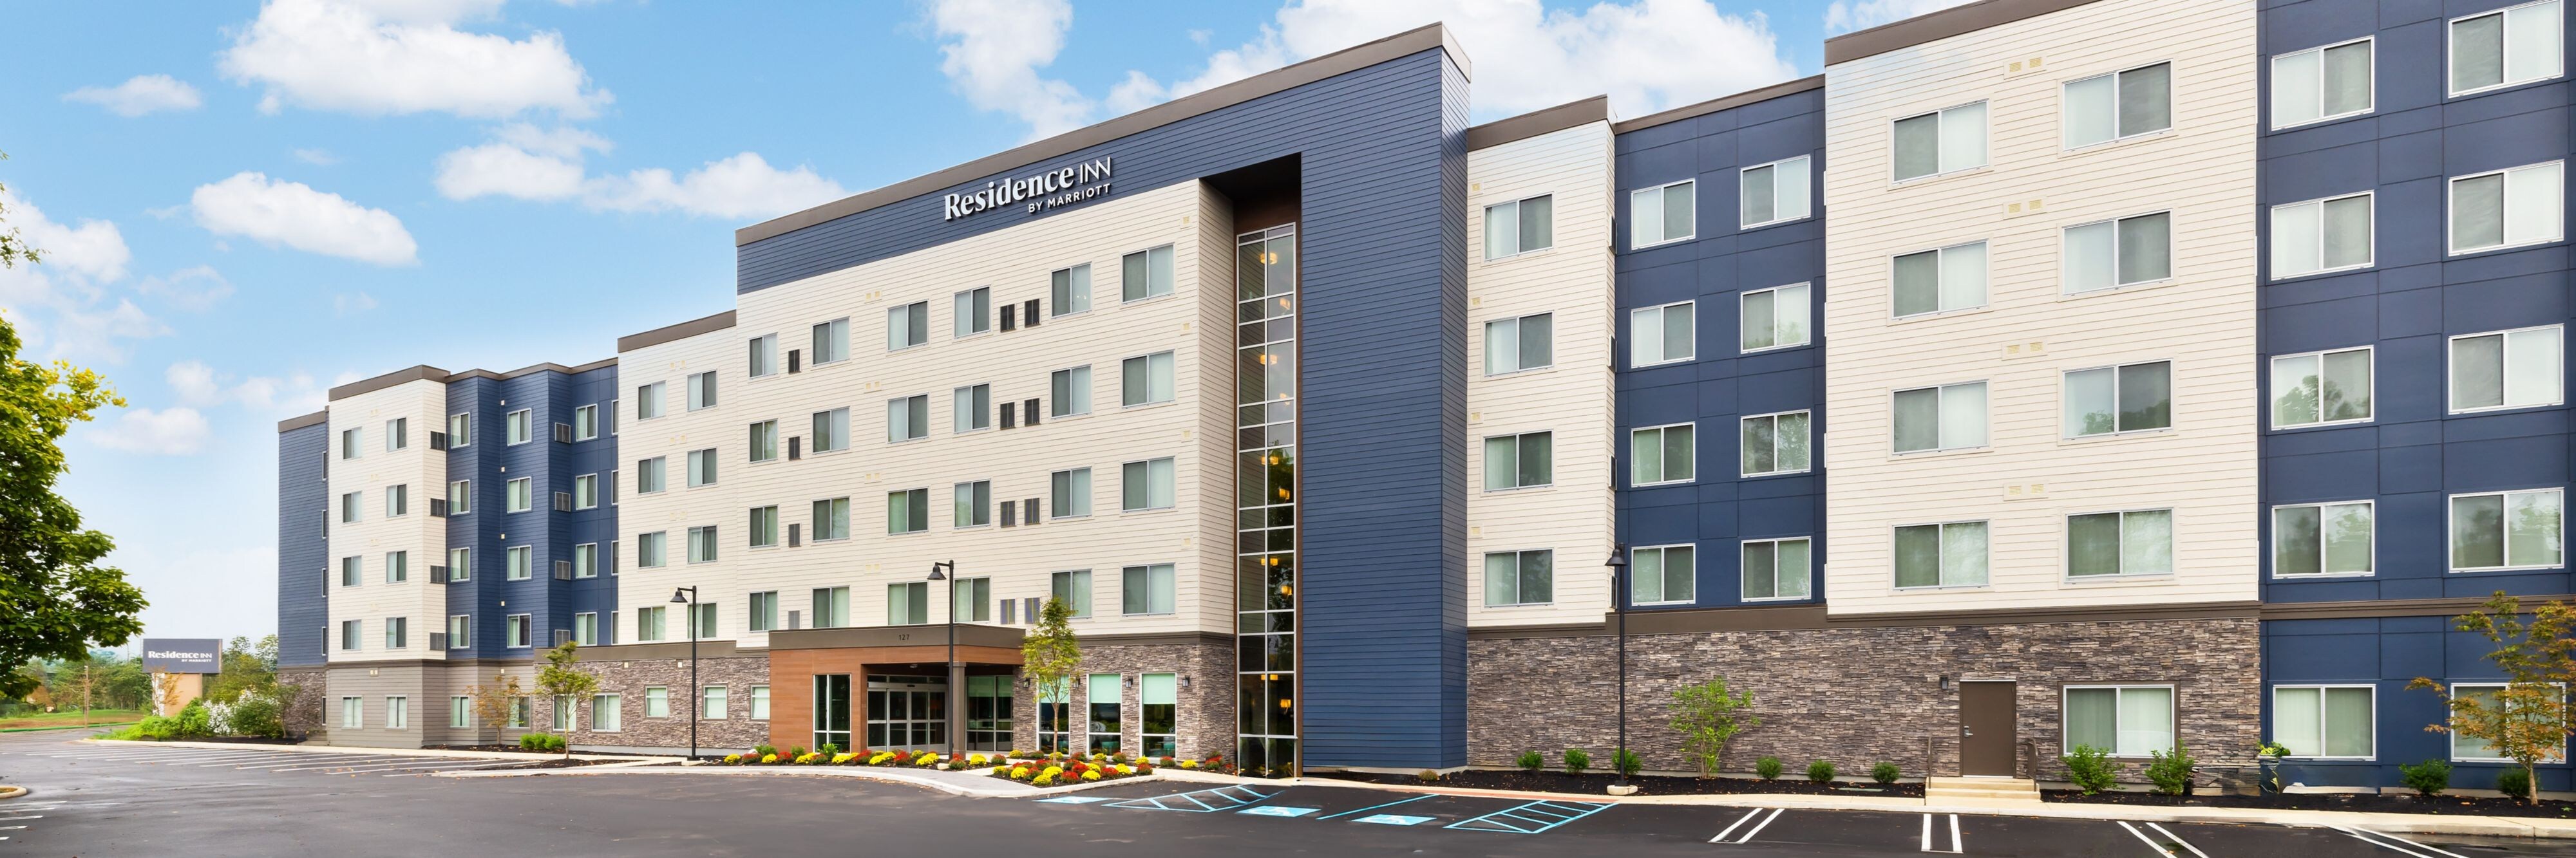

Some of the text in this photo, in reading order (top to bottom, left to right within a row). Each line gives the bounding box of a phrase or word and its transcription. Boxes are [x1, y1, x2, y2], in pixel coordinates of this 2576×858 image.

[944, 156, 1112, 221] Residence INN
[1028, 183, 1111, 213] BY MARRIOTT
